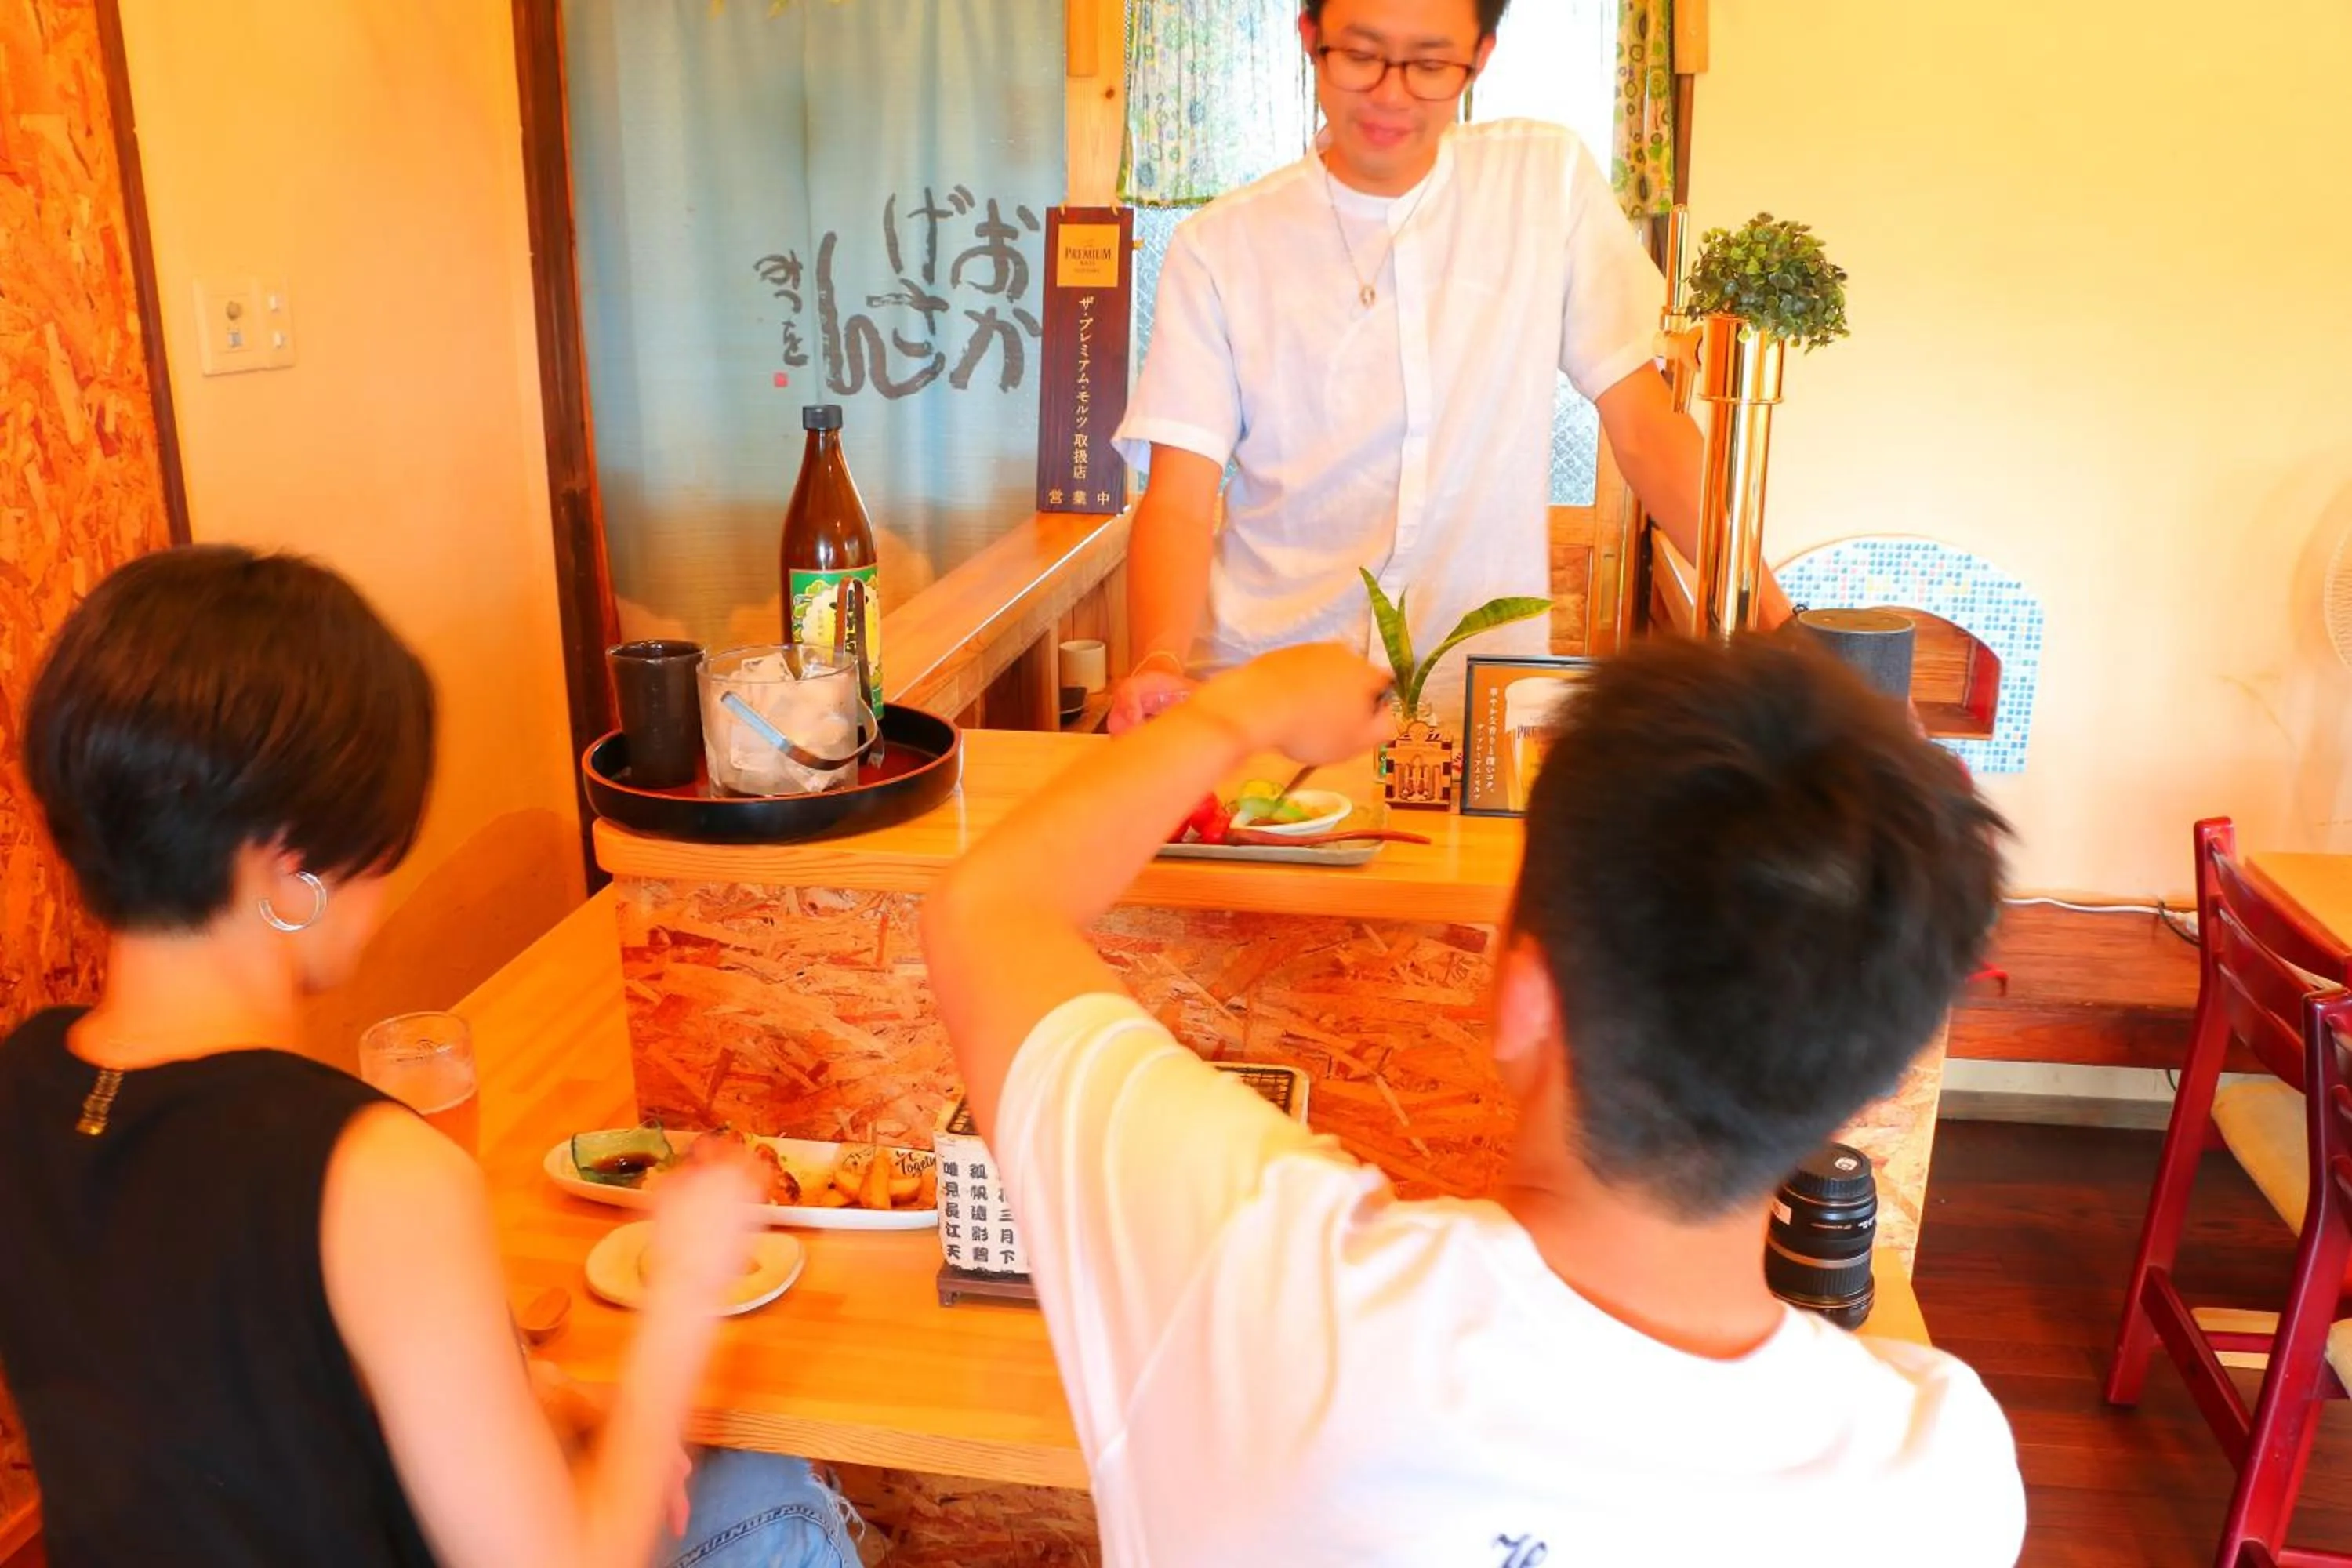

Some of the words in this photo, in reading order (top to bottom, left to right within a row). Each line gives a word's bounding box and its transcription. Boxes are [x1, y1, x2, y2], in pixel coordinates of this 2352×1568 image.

[1065, 246, 1111, 260] PREMIUM
[1076, 296, 1094, 427] ザ・プレミアム・モルツ
[1073, 434, 1088, 480] 取扱店
[1048, 488, 1110, 506] 営業中
[943, 1161, 961, 1266] 唯見長江天
[997, 1187, 1015, 1272] 三月下
